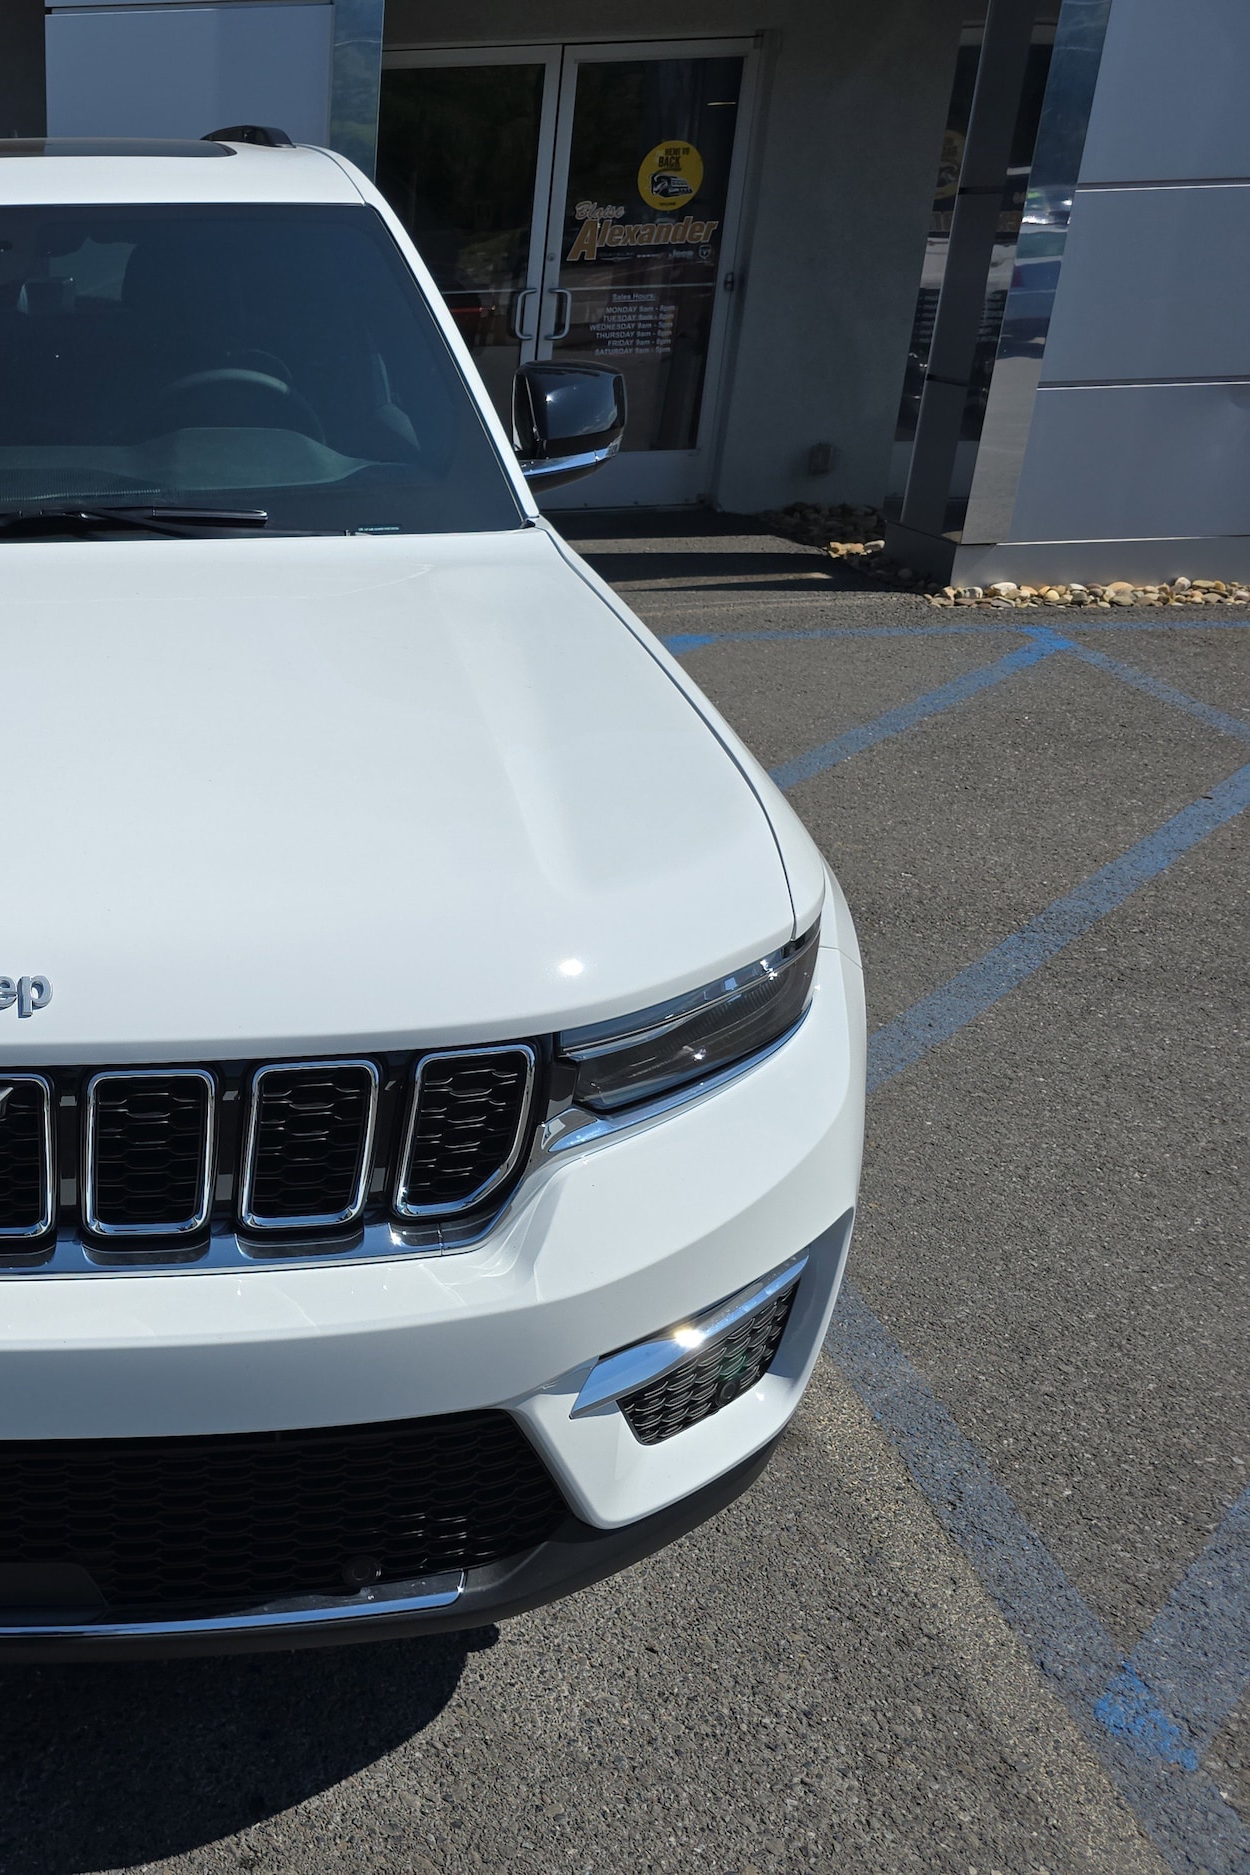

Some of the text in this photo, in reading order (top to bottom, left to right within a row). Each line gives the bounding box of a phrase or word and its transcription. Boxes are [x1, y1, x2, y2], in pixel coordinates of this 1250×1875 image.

[658, 156, 681, 168] BACK
[574, 200, 625, 220] Blaise
[566, 216, 719, 262] Alexander
[612, 293, 632, 301] Sales
[603, 314, 637, 322] TUESDAY
[589, 323, 636, 331] WEDNESDAY
[596, 331, 635, 339] THURSDAY
[594, 347, 633, 356] SATURDAY
